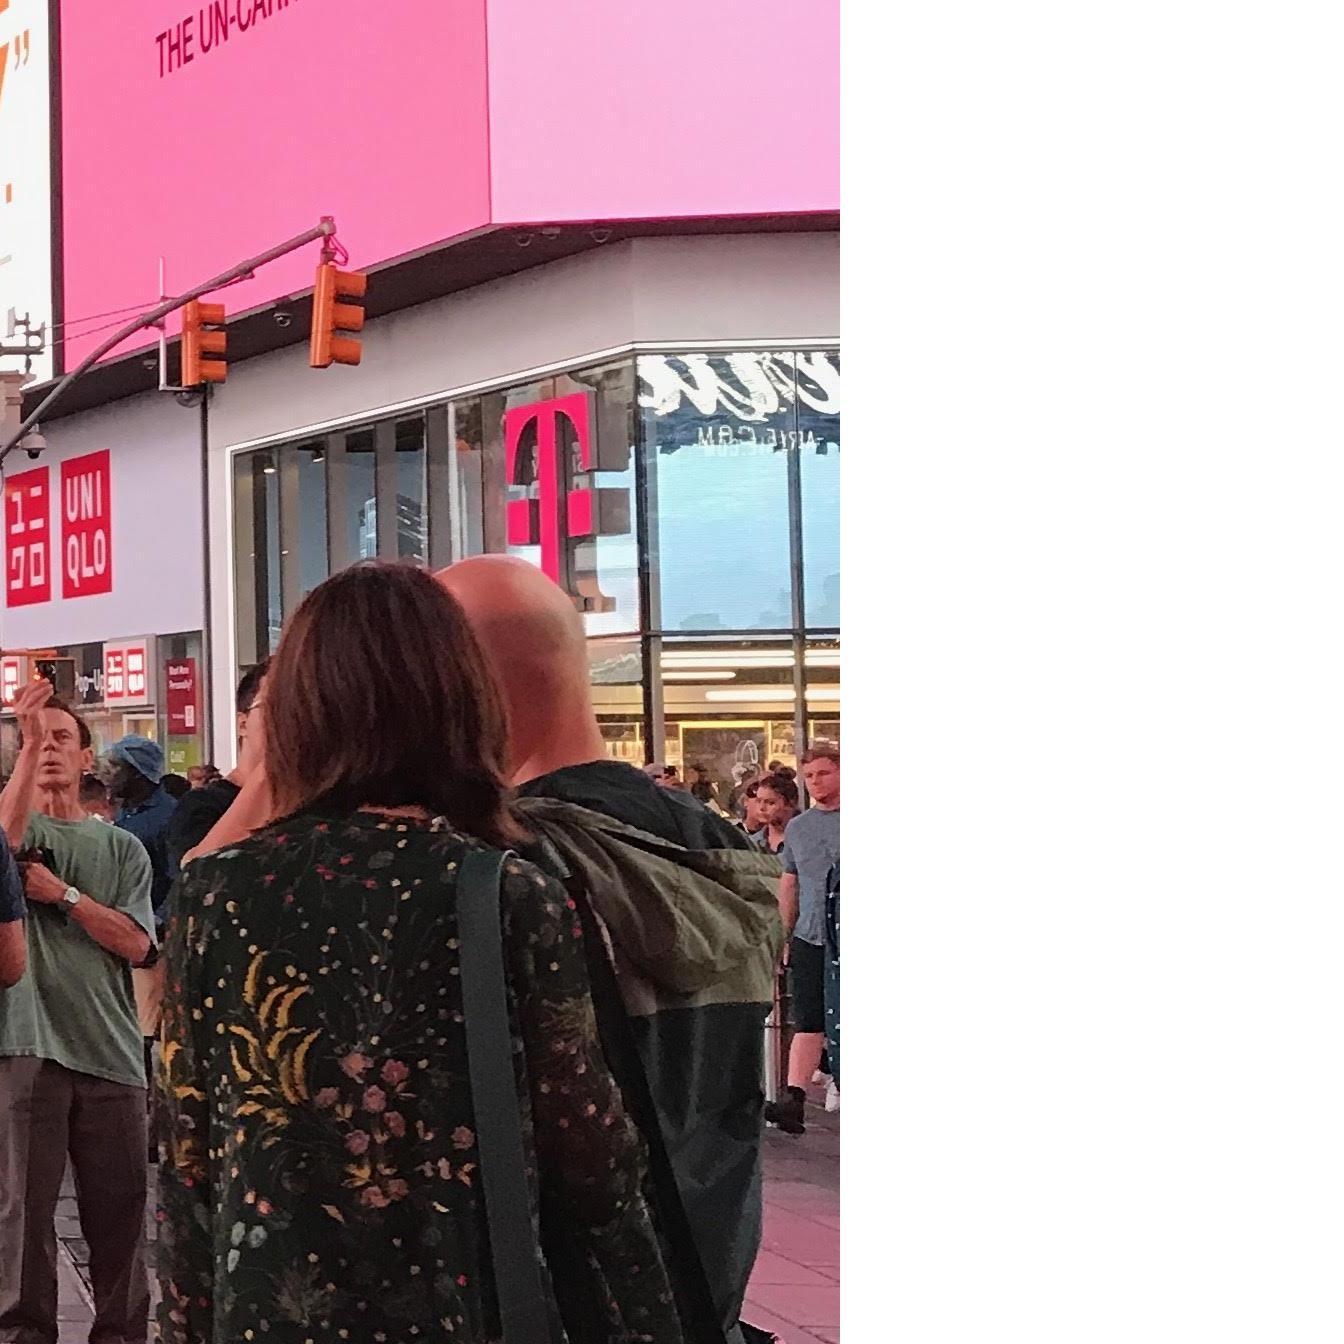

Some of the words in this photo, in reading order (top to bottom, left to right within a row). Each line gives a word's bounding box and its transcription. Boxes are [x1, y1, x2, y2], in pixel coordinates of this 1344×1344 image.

[155, 15, 194, 78] THE
[66, 469, 102, 523] UNI
[67, 528, 106, 588] QLO
